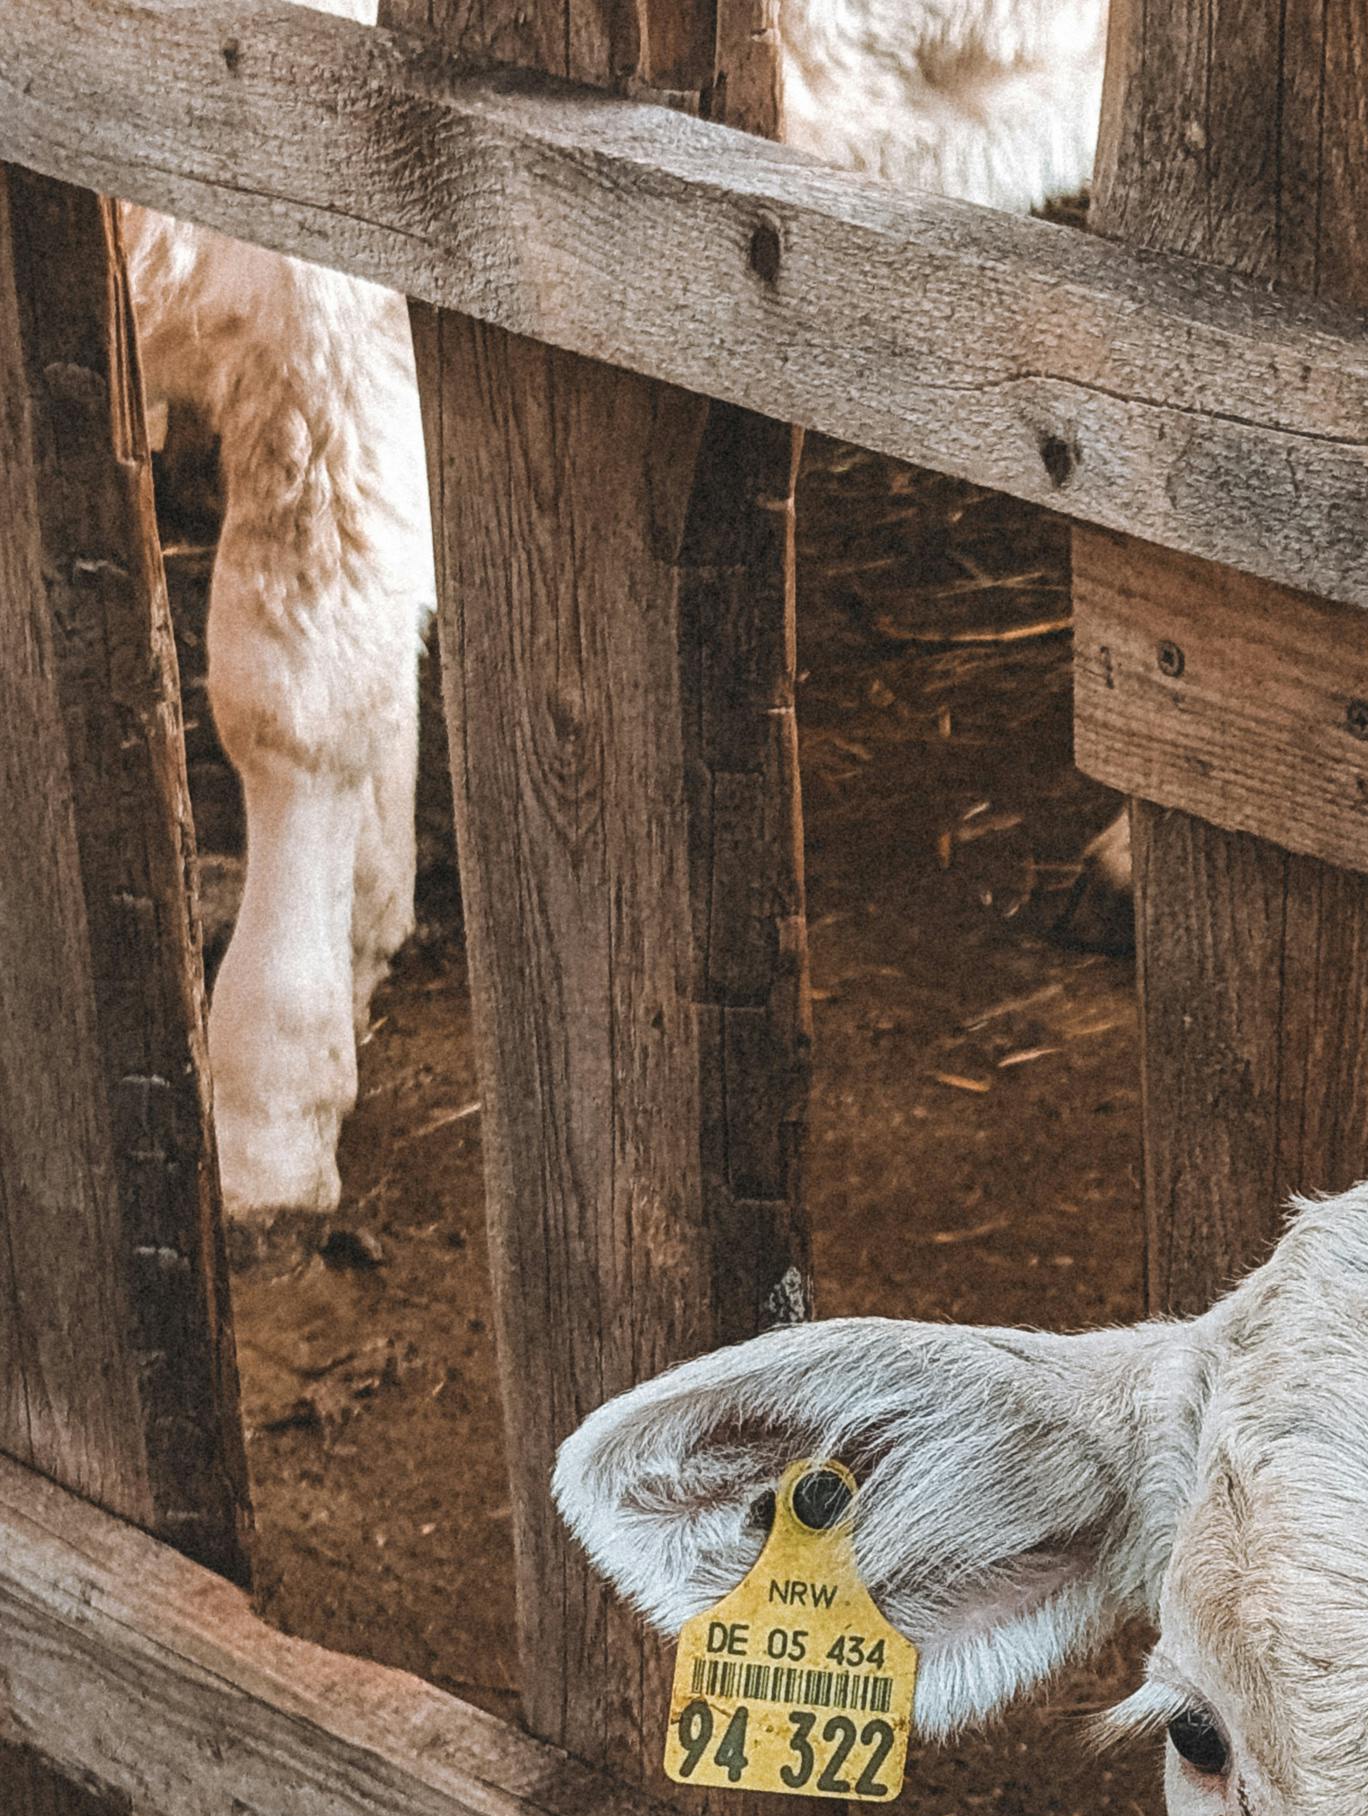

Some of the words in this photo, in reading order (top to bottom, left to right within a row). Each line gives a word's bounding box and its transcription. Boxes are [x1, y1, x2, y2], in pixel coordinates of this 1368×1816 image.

[768, 1579, 838, 1609] NRW
[706, 1621, 750, 1656] DE
[767, 1628, 809, 1663] 05
[826, 1635, 886, 1670] 434
[678, 1699, 749, 1783] 94
[779, 1710, 895, 1797] 322
